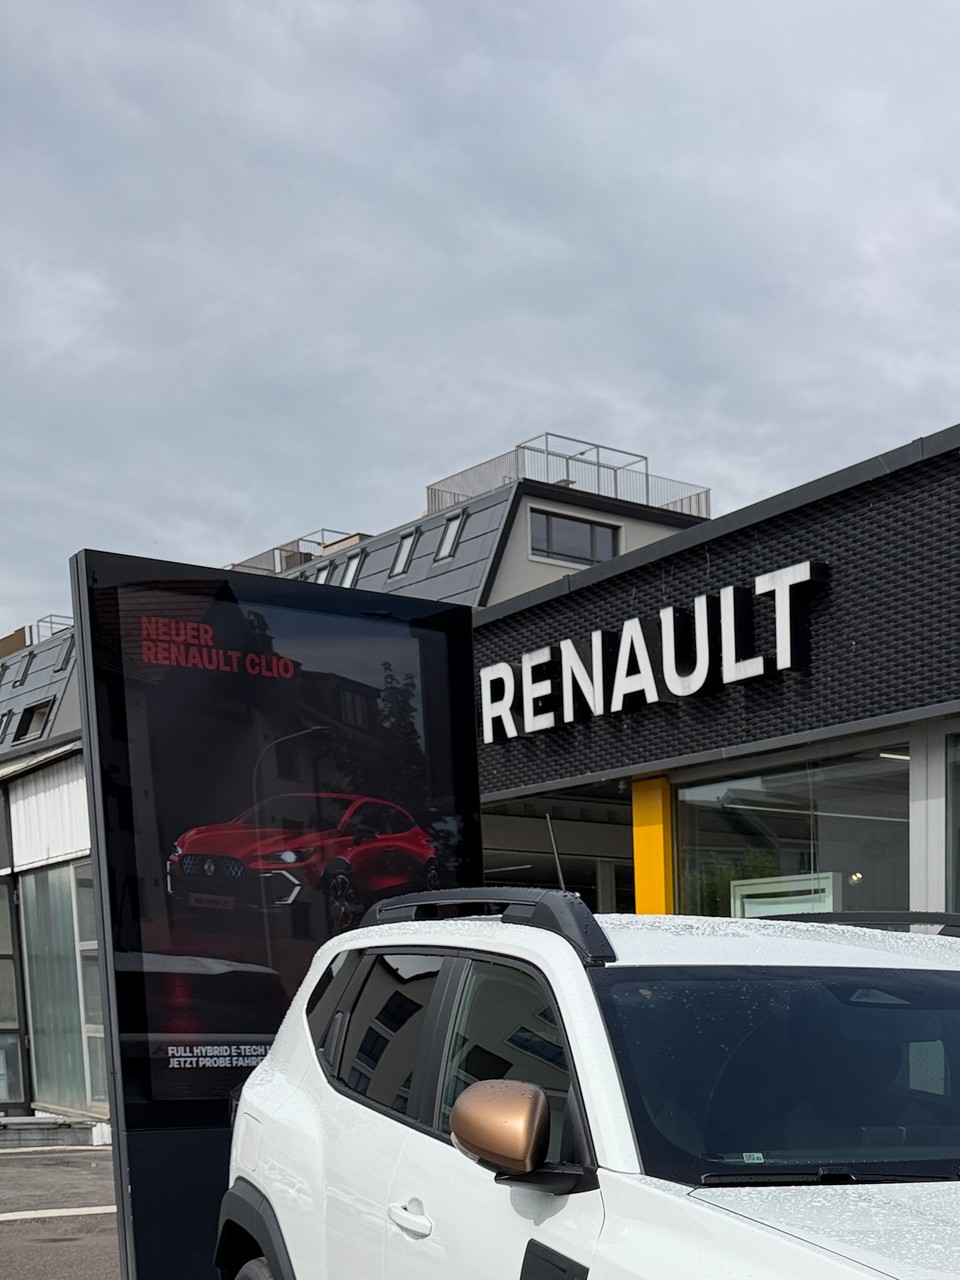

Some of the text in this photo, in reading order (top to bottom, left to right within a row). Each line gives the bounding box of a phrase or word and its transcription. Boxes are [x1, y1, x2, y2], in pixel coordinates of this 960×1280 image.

[141, 616, 214, 646] NEUER
[142, 640, 294, 679] RENAULT CLIO
[480, 561, 811, 744] RENAULT
[168, 1046, 193, 1057] FULL
[193, 1046, 230, 1057] HYBRID
[231, 1045, 265, 1056] E-TECH
[169, 1057, 198, 1068] JETZT
[199, 1057, 231, 1068] PROBE
